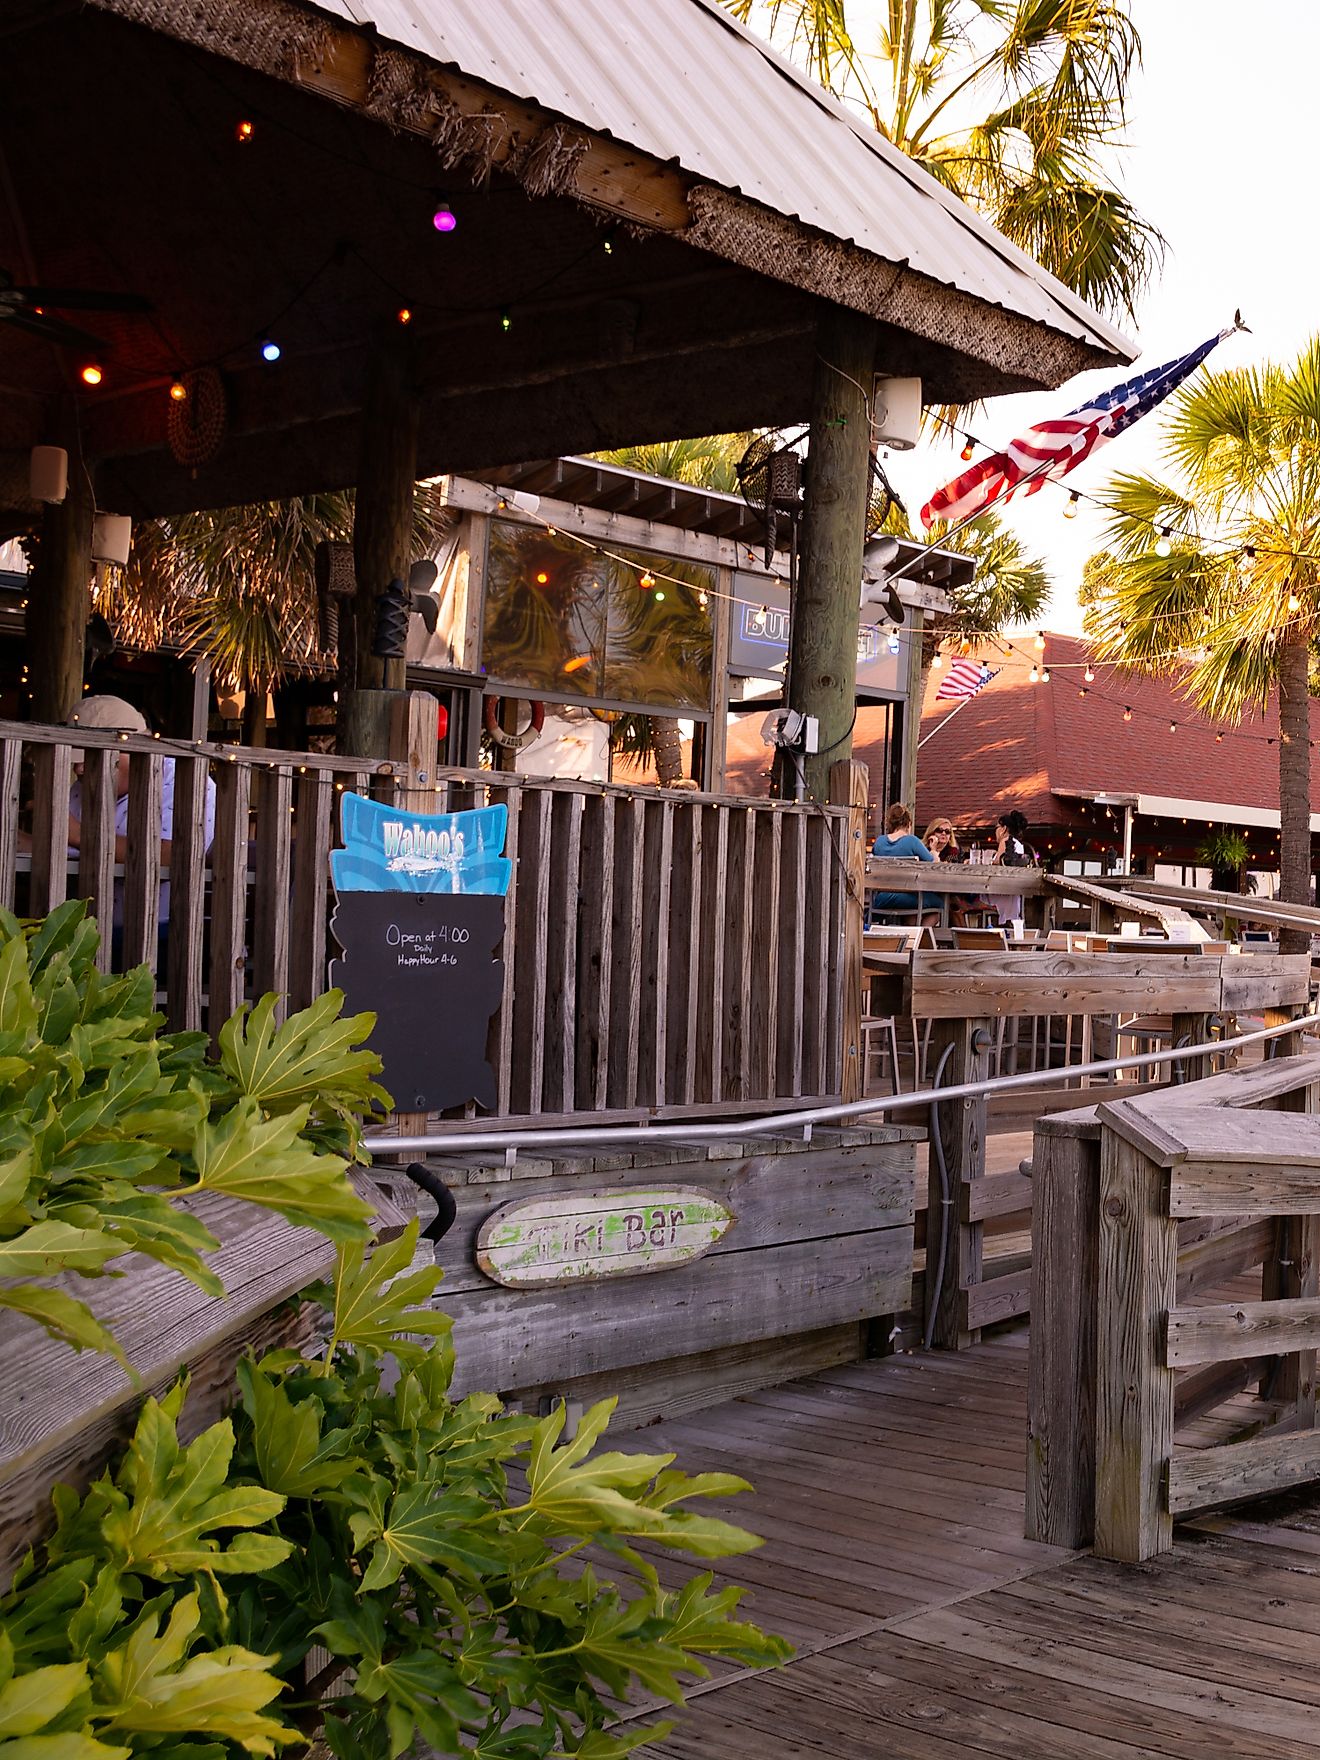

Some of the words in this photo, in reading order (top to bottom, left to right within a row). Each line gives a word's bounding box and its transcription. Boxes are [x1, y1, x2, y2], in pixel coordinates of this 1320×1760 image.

[383, 821, 465, 860] Wahoo's
[386, 923, 422, 947] Open
[424, 930, 437, 943] at
[438, 925, 470, 943] 4:00
[413, 944, 433, 954] Daily
[622, 1209, 685, 1252] Bar
